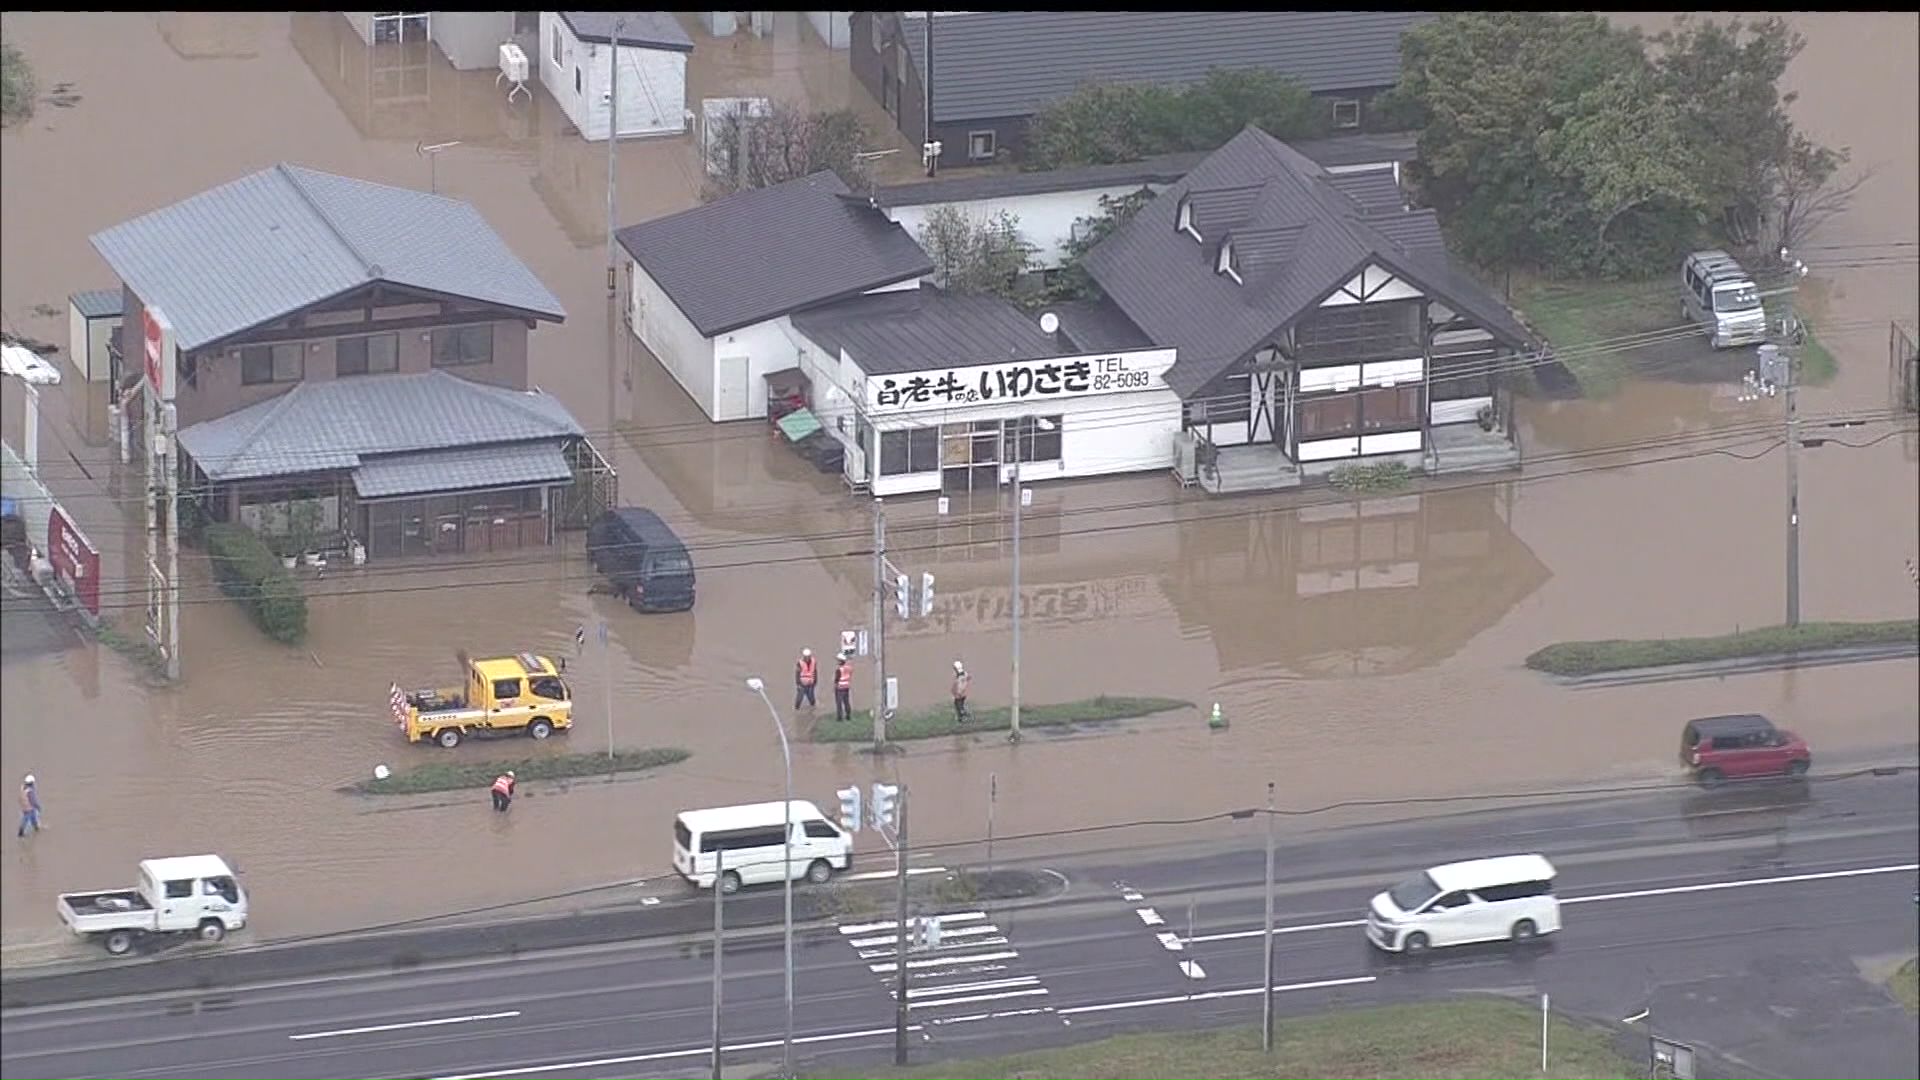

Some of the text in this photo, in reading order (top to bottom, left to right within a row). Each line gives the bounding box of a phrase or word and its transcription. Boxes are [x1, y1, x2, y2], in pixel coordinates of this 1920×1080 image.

[1095, 357, 1129, 373] TEL
[980, 361, 1091, 399] いわさき
[1093, 371, 1149, 390] 82-5093
